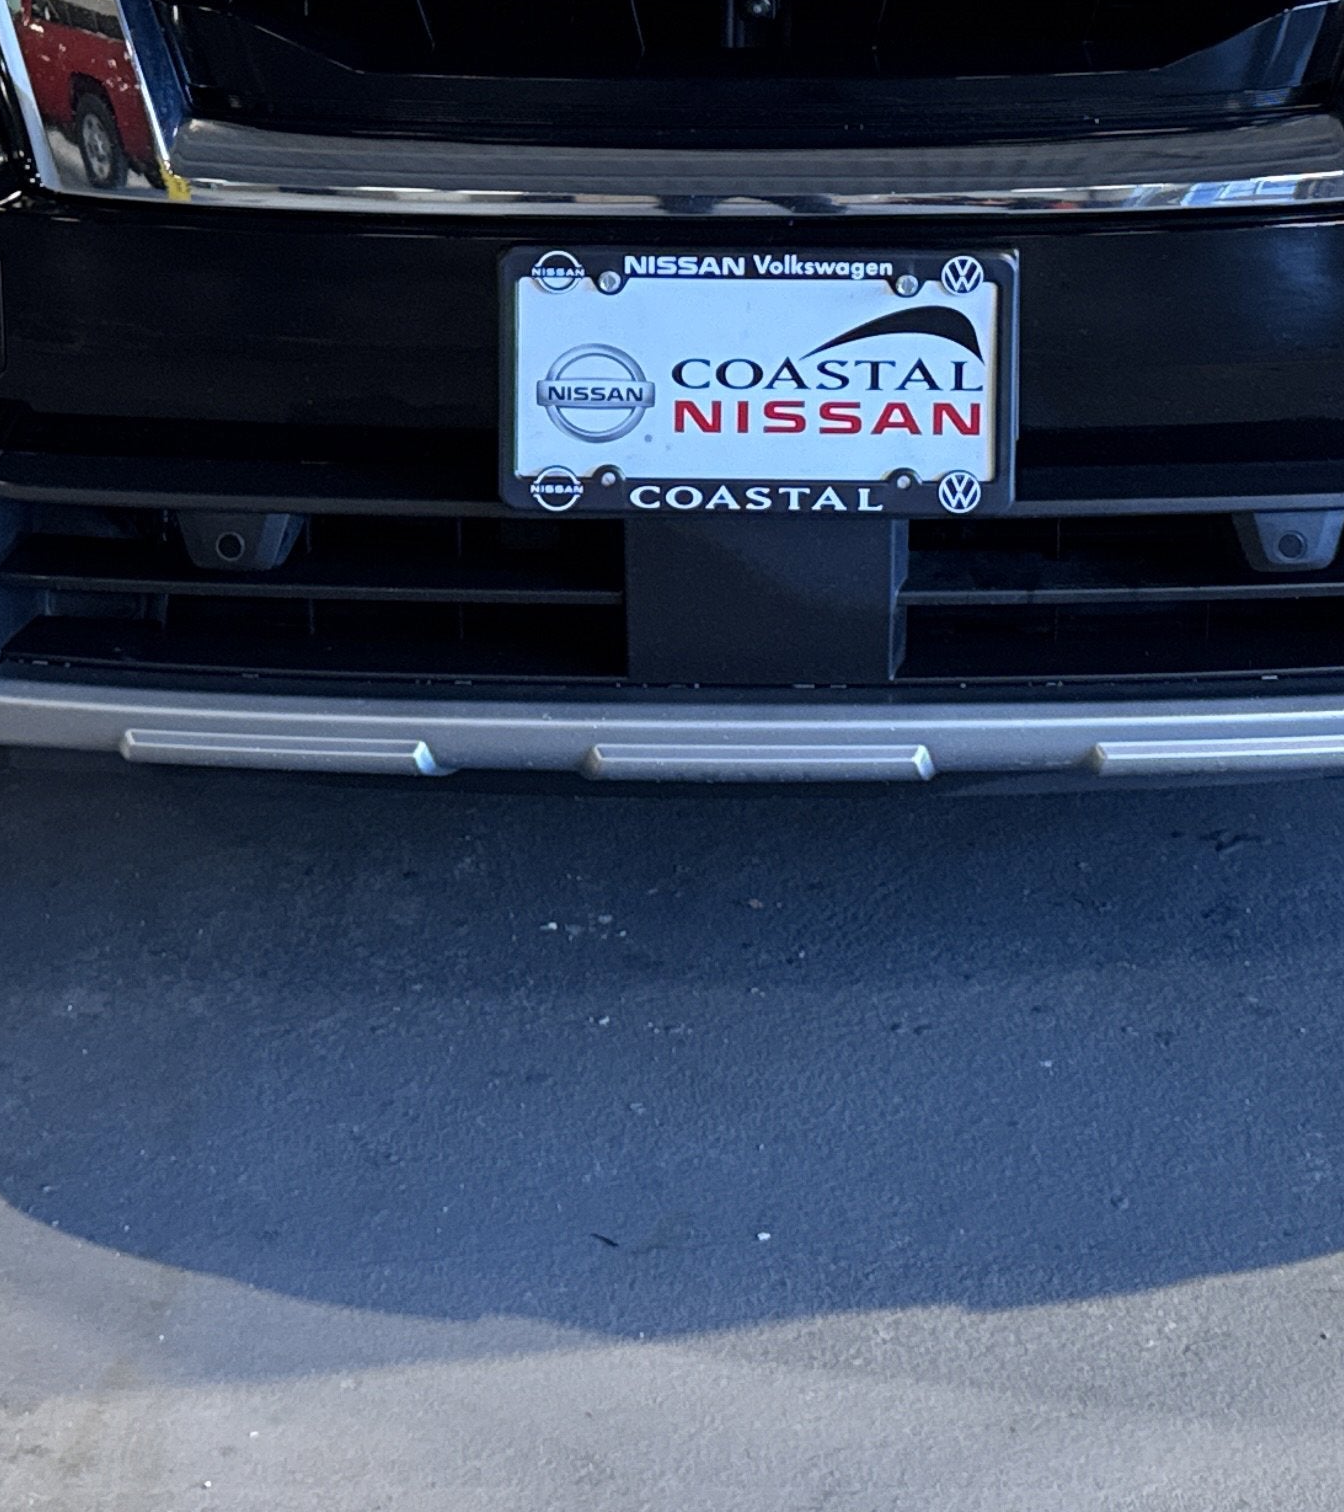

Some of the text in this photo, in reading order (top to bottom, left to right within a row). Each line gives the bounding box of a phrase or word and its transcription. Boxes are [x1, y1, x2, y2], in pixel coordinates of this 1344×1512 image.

[531, 266, 585, 277] NISSAN
[624, 254, 893, 280] NISSAN Volkswagen
[671, 358, 984, 392] COASTAL
[548, 385, 644, 402] NISSAN
[674, 400, 982, 436] NISSAN
[530, 484, 584, 494] NISSAN
[630, 484, 884, 511] COASTAL
